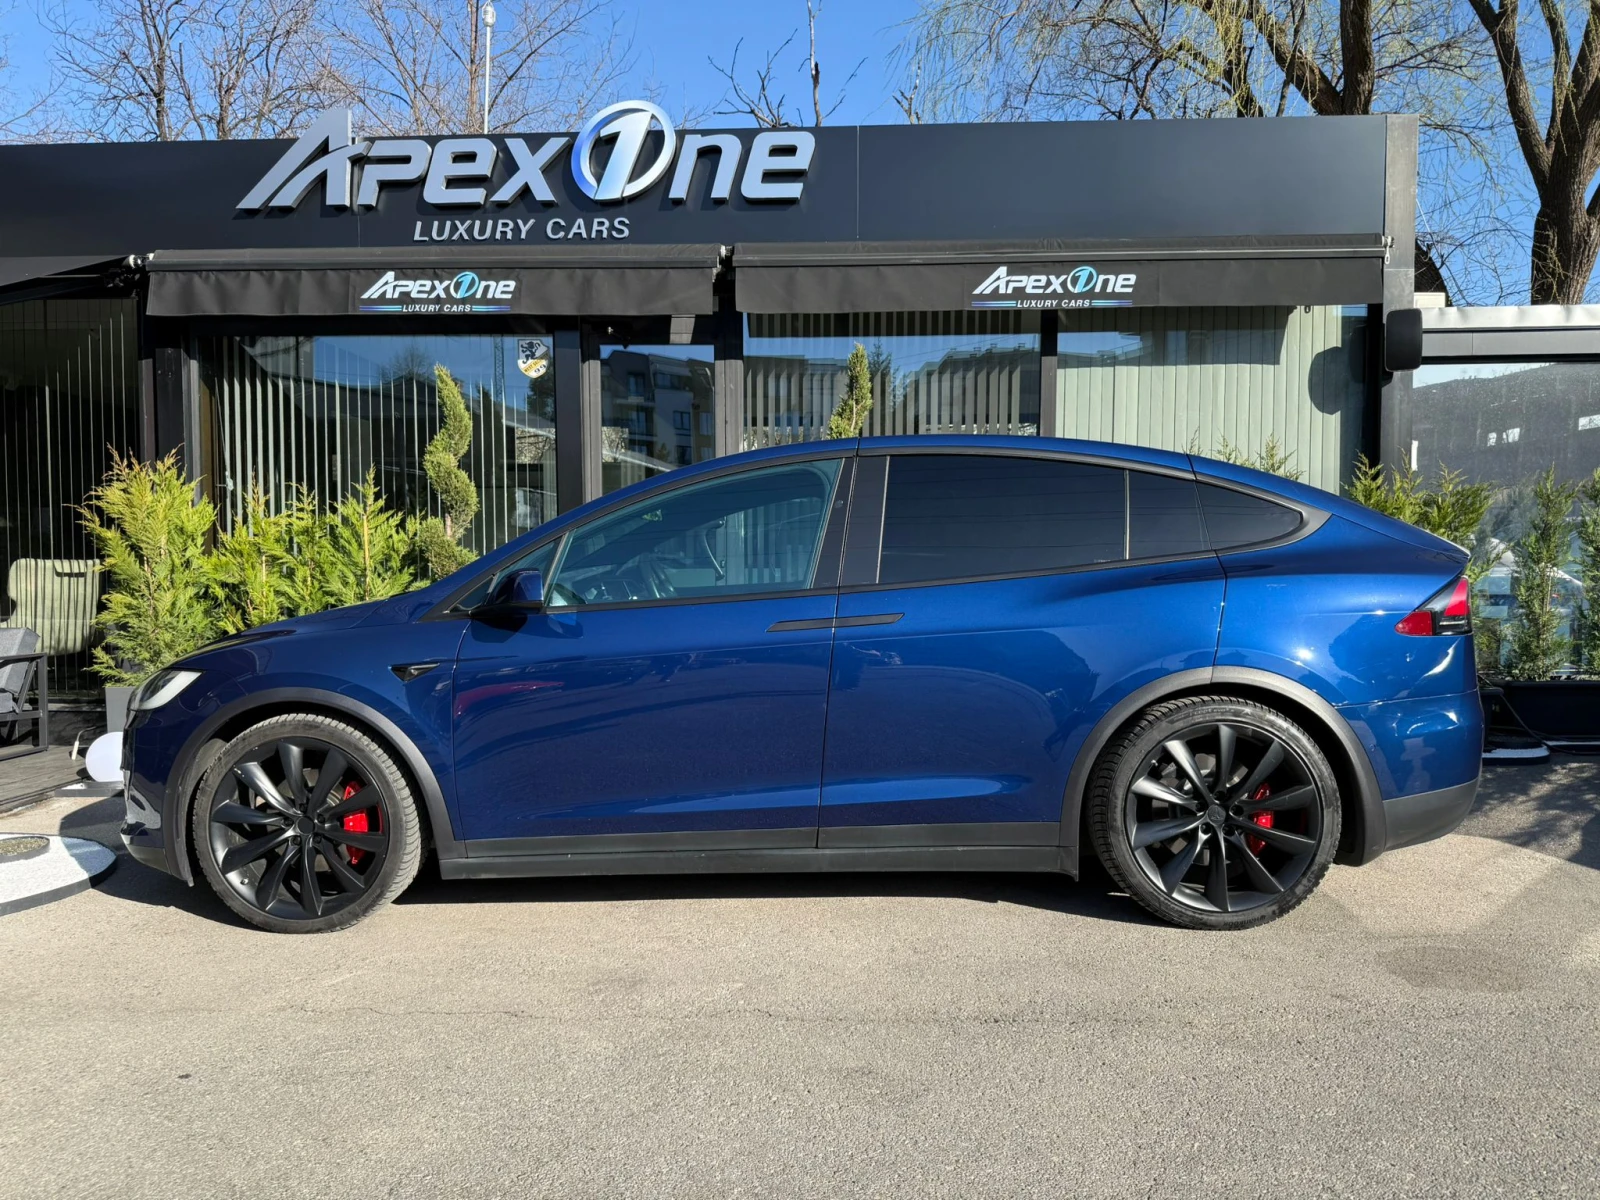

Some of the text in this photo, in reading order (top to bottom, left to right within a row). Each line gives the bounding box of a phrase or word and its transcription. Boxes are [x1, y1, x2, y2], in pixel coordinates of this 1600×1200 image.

[413, 217, 630, 242] LUXURY CARS
[1017, 299, 1090, 308] LUXURY CARS
[402, 304, 471, 313] LUXURY CARS
